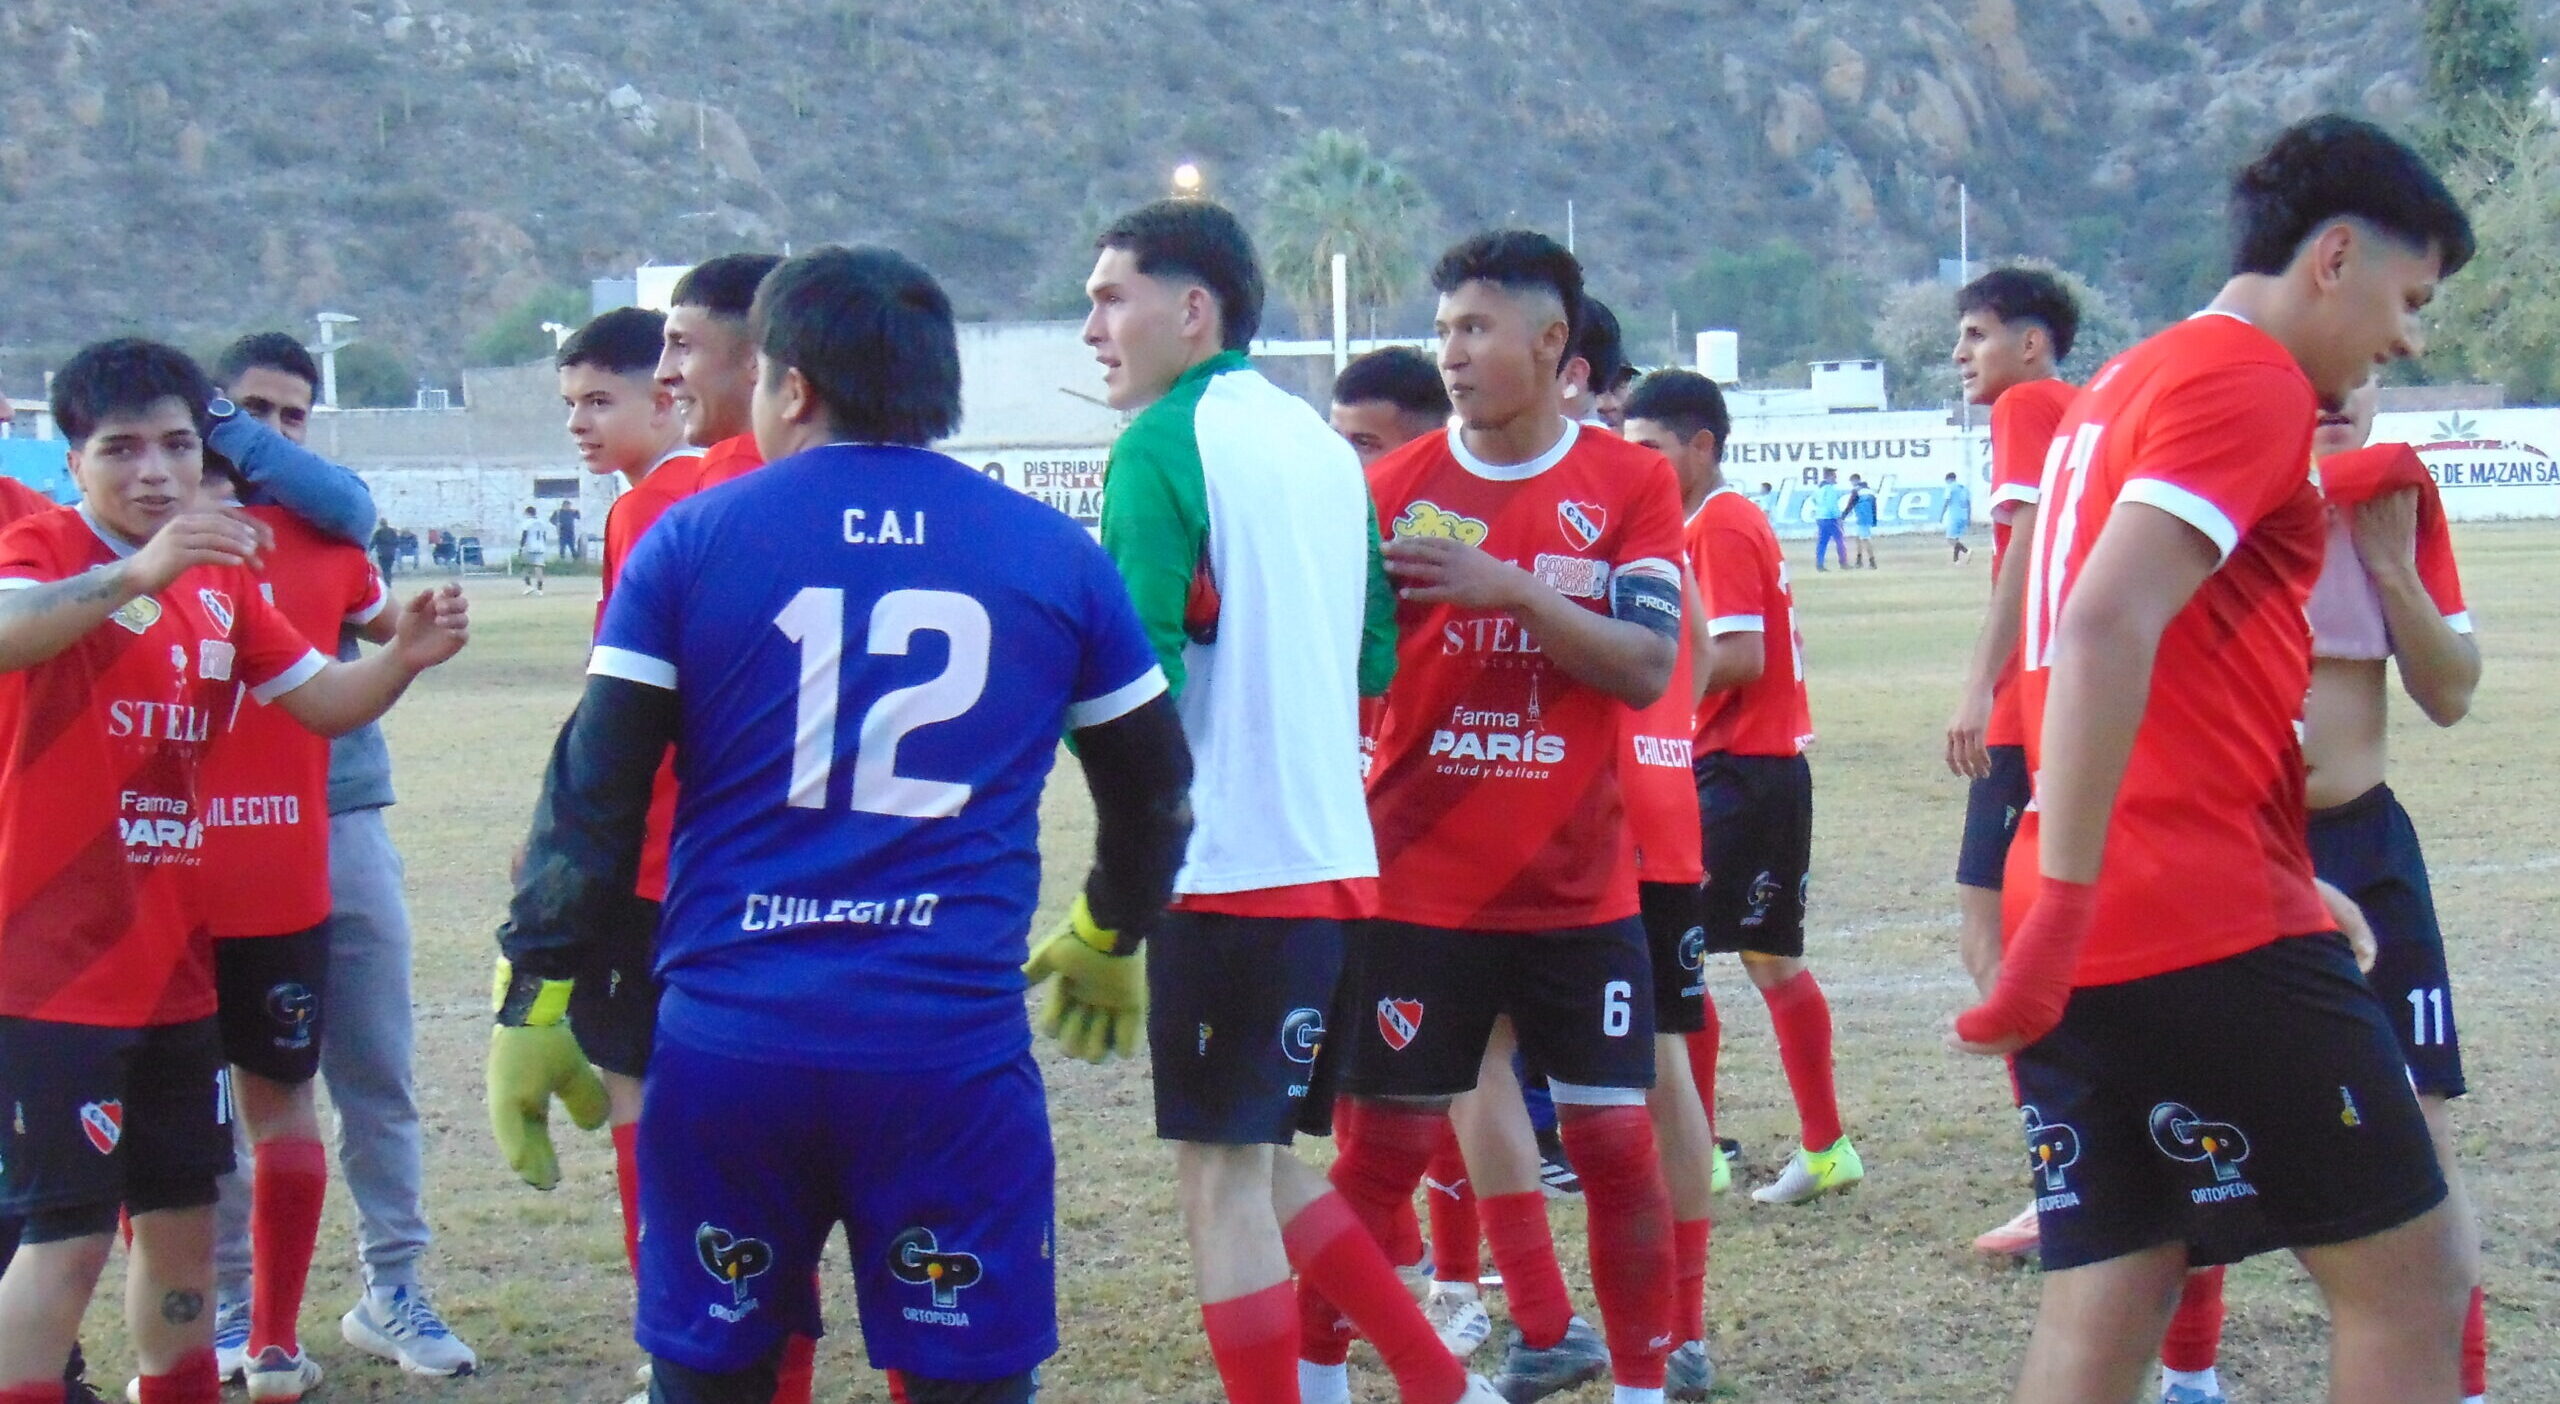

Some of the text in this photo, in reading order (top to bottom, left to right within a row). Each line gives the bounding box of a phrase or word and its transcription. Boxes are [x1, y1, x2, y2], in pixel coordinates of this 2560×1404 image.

[2444, 463, 2463, 484] DE
[2470, 462, 2532, 483] MAZAN
[843, 508, 925, 545] C.A.I
[1442, 617, 1542, 656] STEL
[773, 586, 991, 818] 12
[1452, 705, 1520, 728] Farma
[1429, 729, 1566, 764] PARÍS
[1633, 735, 1693, 768] CHILECIT
[1436, 763, 1550, 780] salud y belleza
[206, 795, 299, 827] ILECITO
[1603, 980, 1632, 1038] 6
[2406, 988, 2444, 1045] 11
